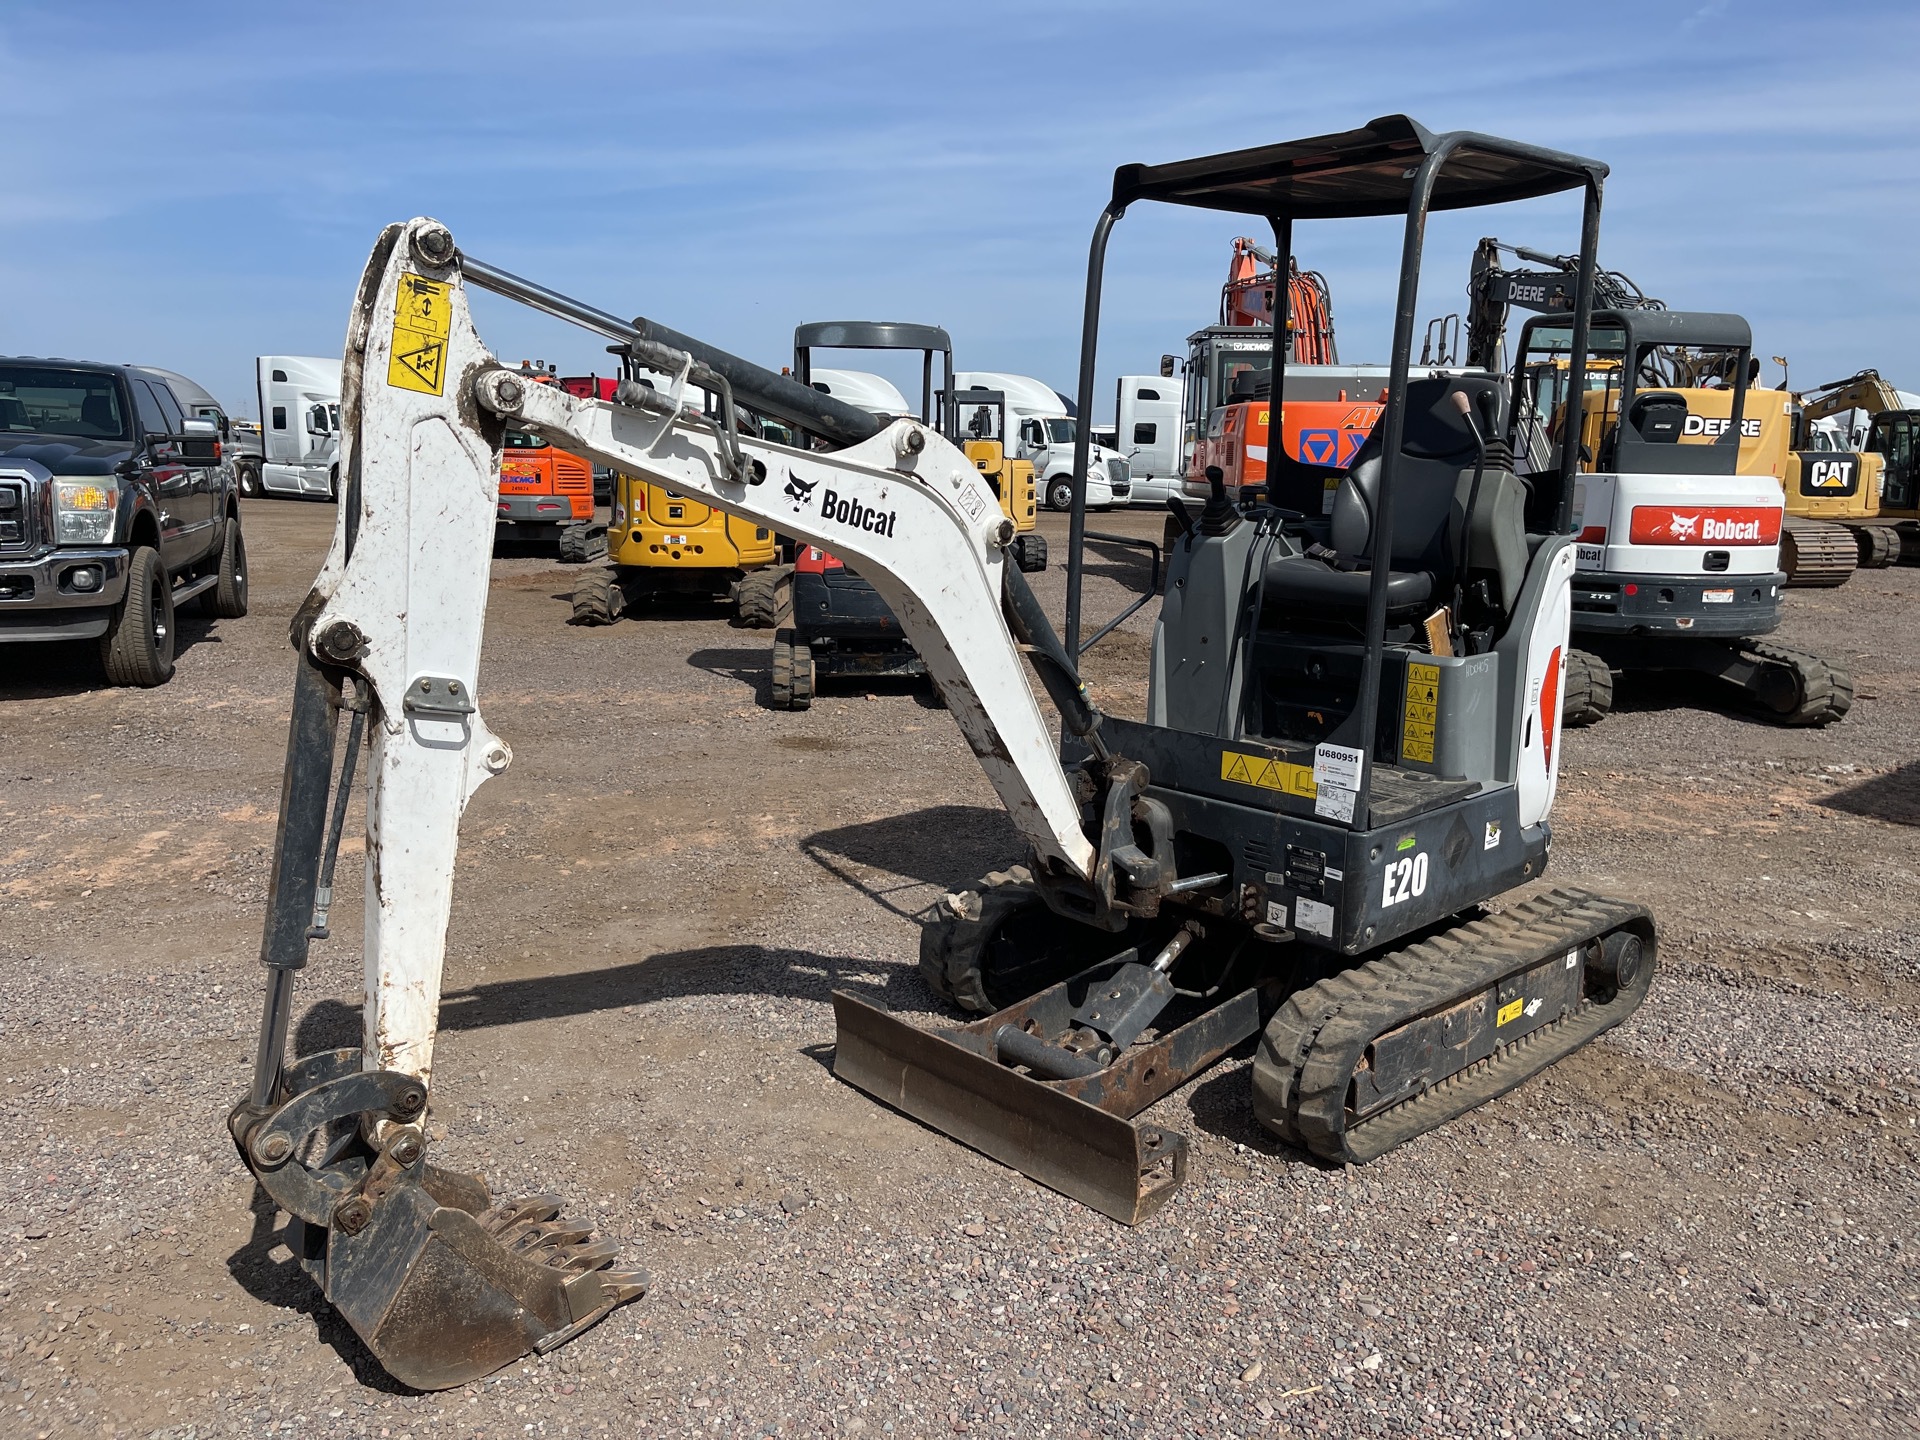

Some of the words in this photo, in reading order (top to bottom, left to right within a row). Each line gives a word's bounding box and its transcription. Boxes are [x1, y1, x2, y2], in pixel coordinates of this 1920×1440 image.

[1508, 281, 1546, 303] DEERE
[1241, 343, 1271, 351] XCMG
[1683, 415, 1761, 437] DEERE
[508, 475, 535, 484] XCMG
[1811, 461, 1853, 488] CAT
[820, 488, 897, 539] Bobcat
[1702, 518, 1760, 540] Bobcat
[1576, 548, 1601, 561] obcat
[1318, 749, 1358, 763] U680951
[1381, 852, 1428, 909] E20
